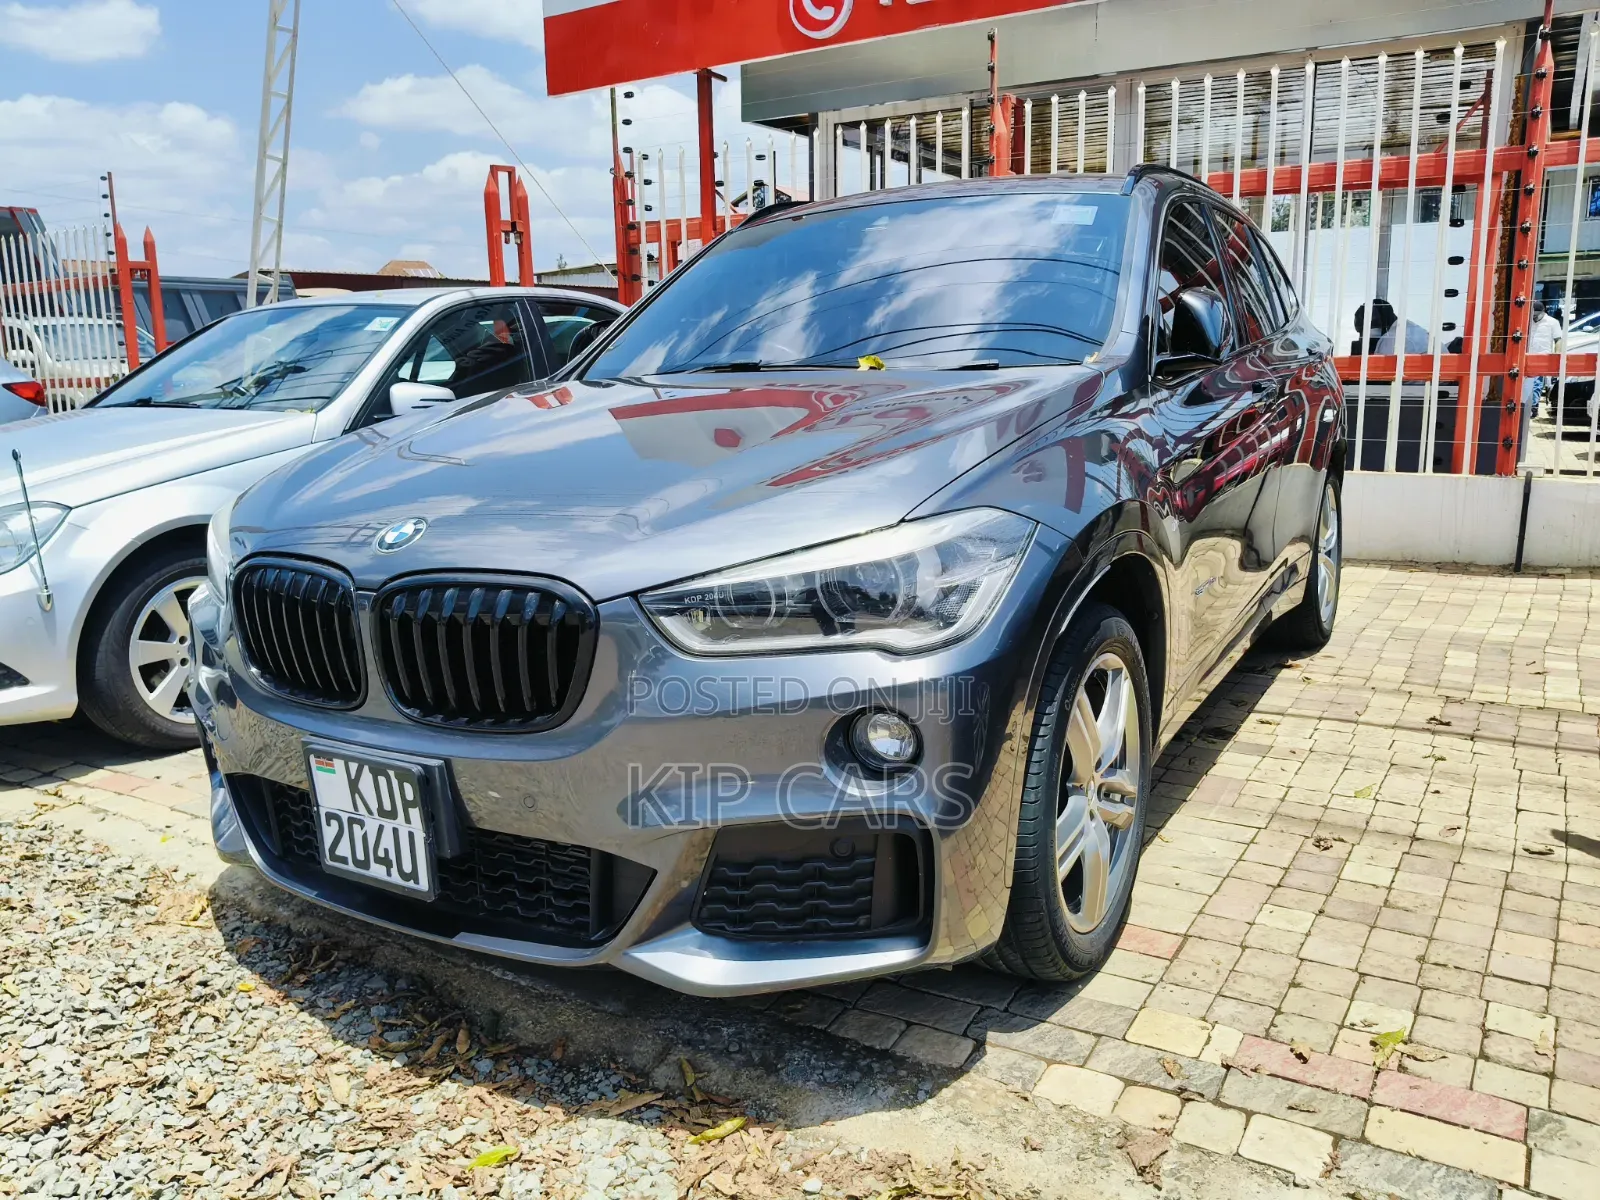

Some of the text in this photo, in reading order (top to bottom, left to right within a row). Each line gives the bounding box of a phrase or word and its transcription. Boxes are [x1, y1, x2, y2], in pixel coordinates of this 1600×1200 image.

[683, 594, 702, 605] KDP
[344, 760, 419, 825] KDP
[325, 811, 419, 885] 204U
